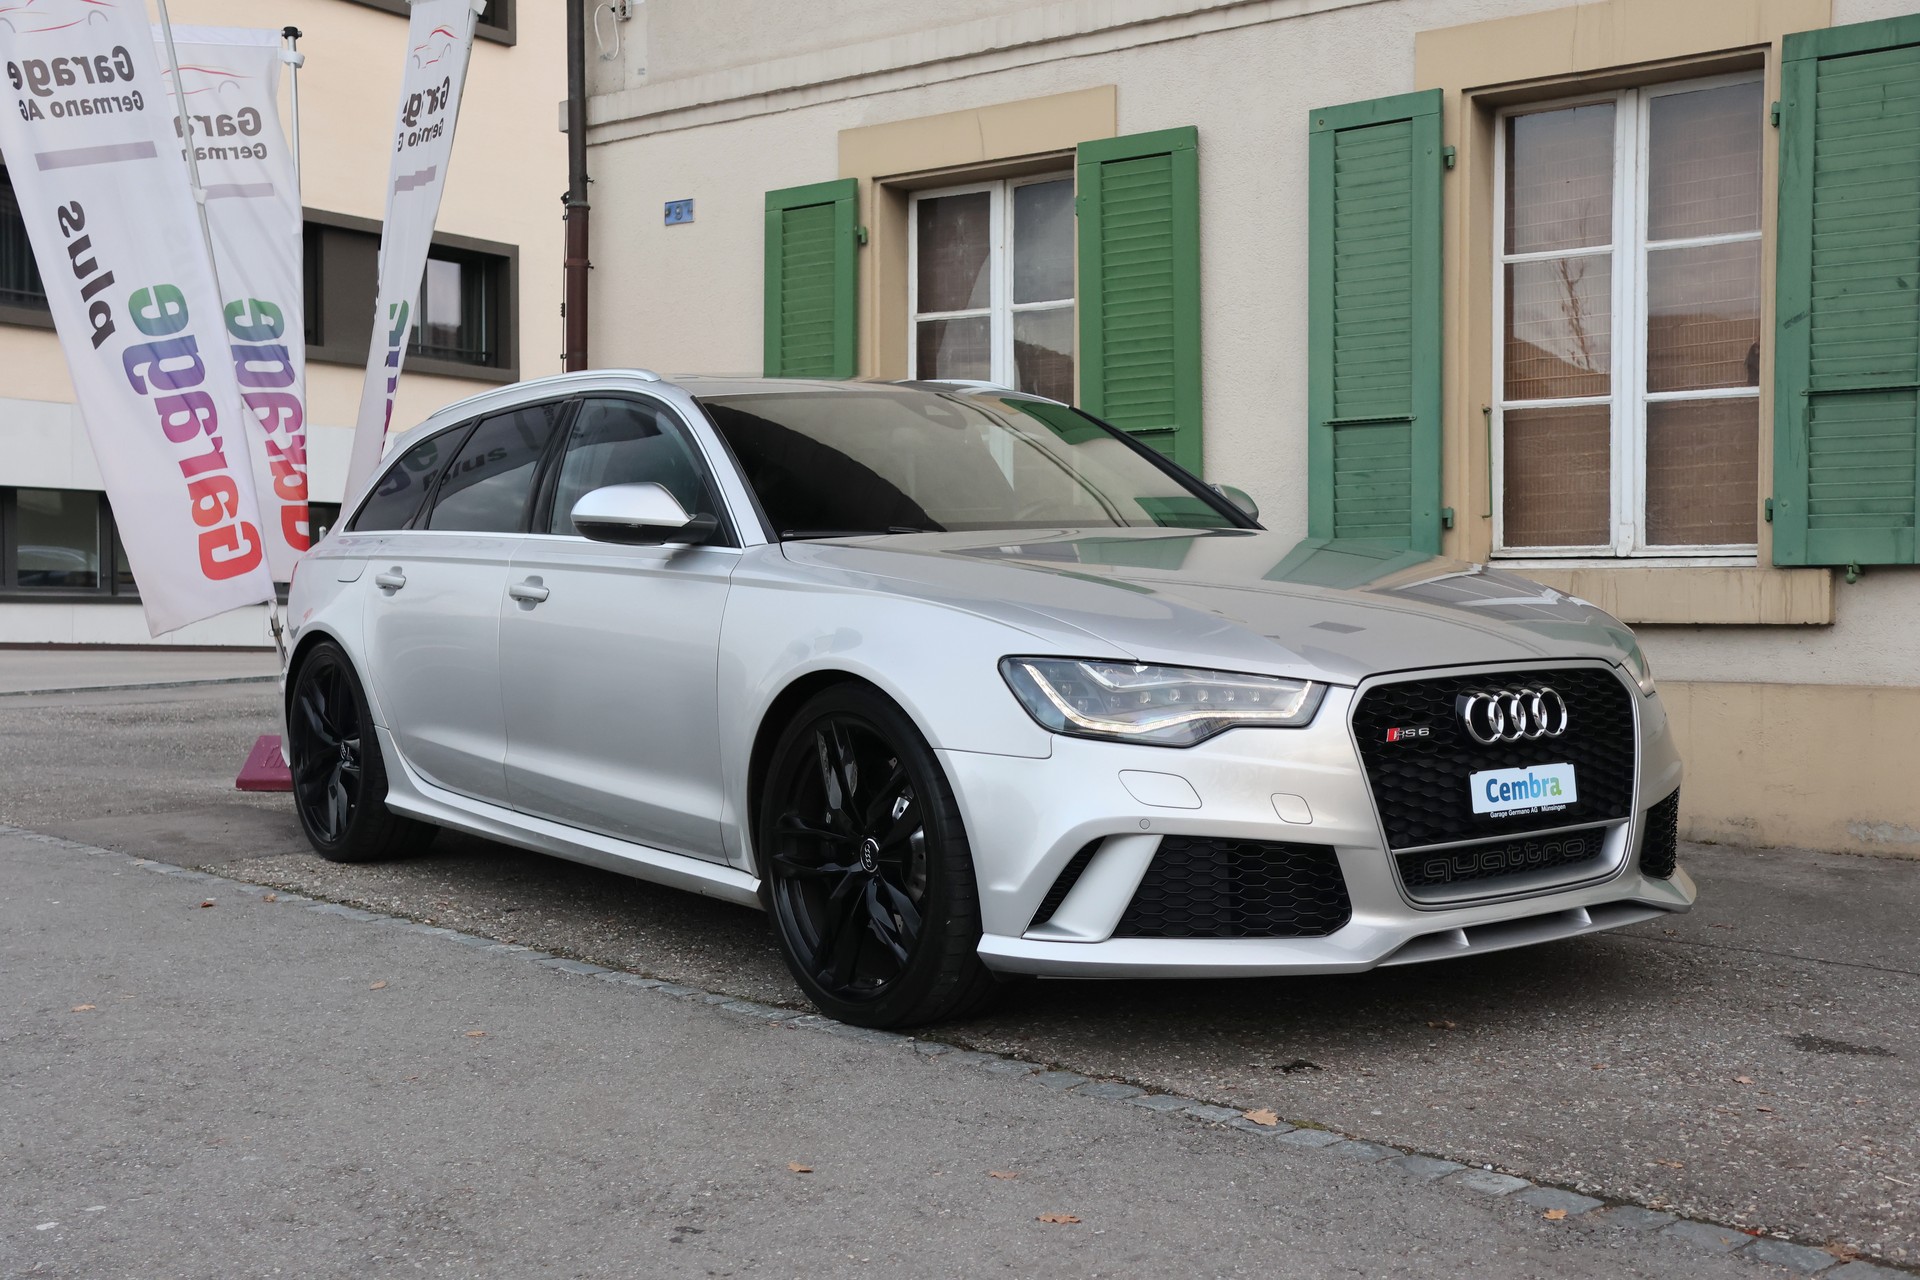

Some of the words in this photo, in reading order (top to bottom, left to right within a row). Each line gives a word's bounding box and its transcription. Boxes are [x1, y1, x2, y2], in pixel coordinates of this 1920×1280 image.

[1485, 772, 1562, 803] Cembra
[1490, 811, 1508, 819] Garage
[1508, 808, 1530, 816] Germano
[1423, 838, 1586, 882] quattro
